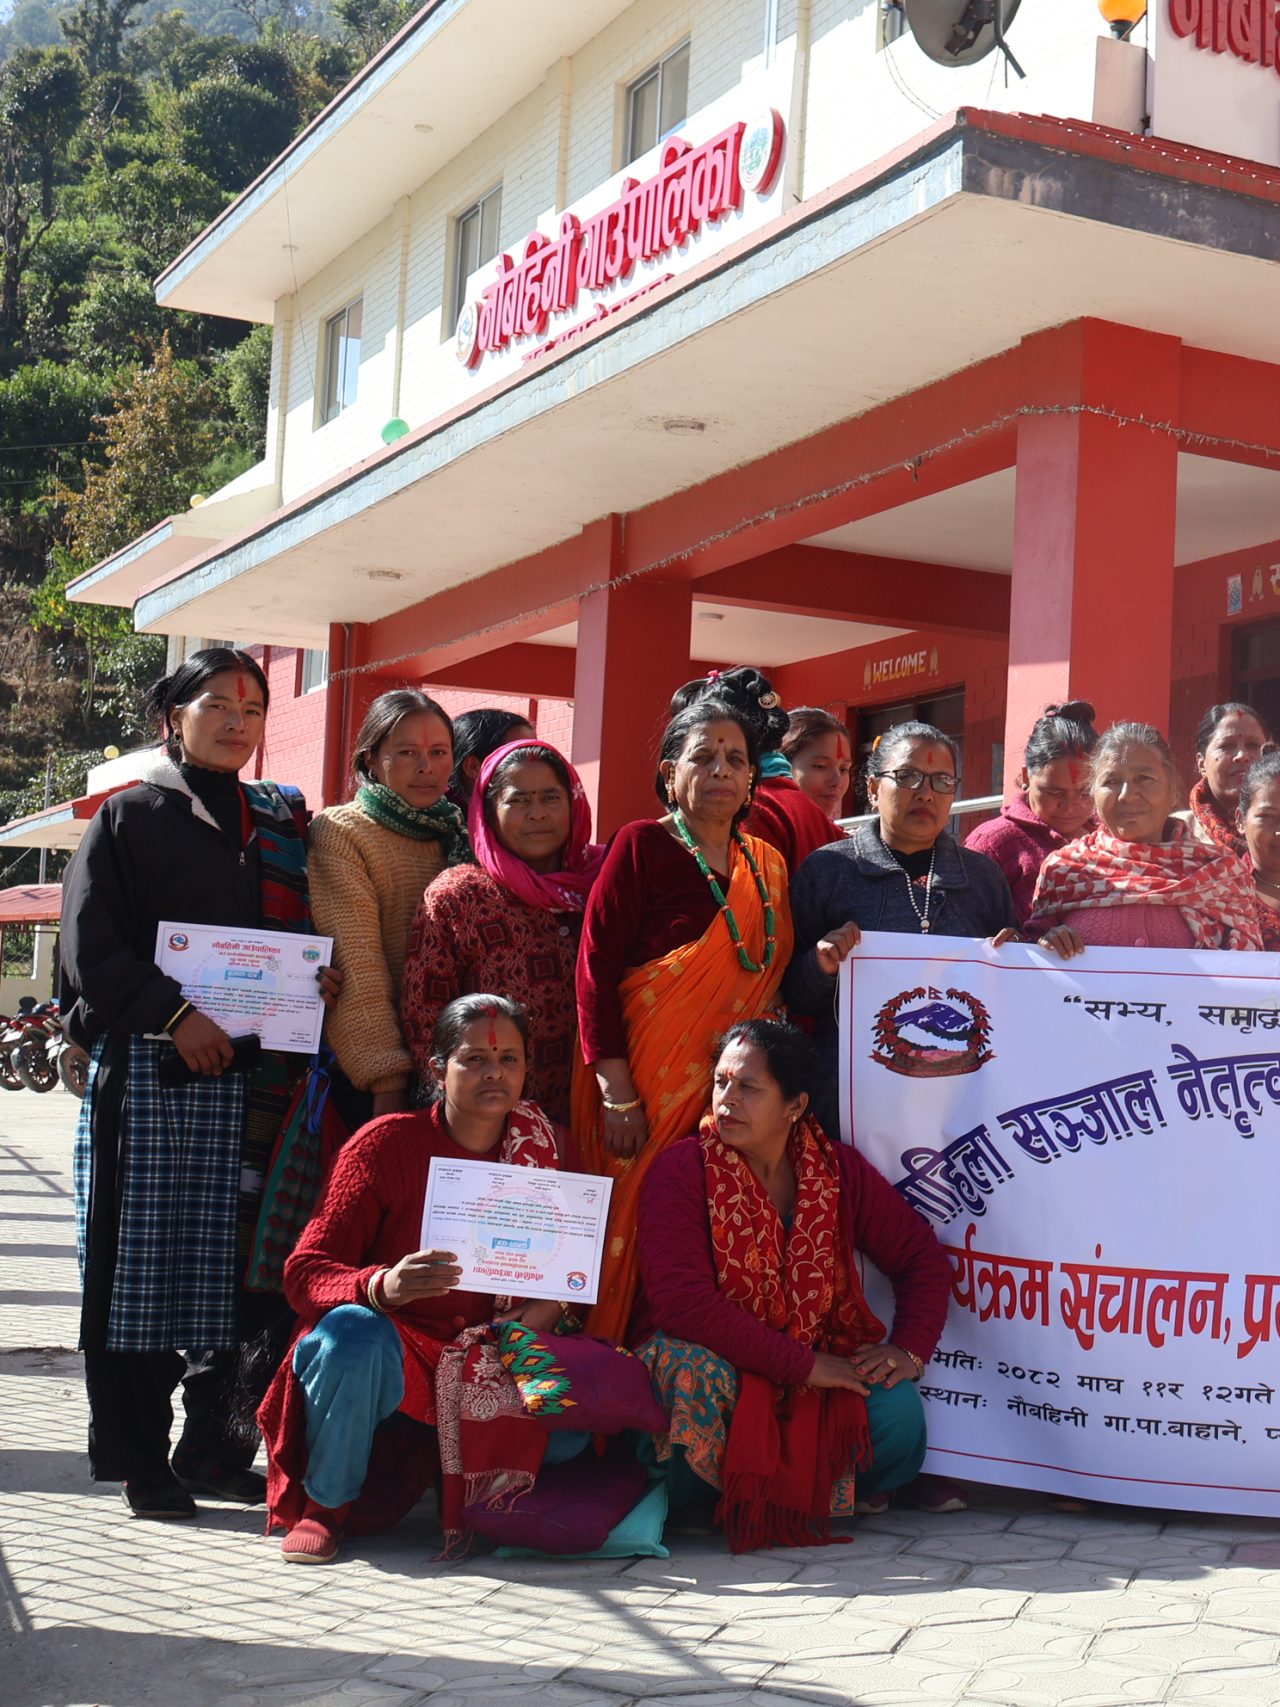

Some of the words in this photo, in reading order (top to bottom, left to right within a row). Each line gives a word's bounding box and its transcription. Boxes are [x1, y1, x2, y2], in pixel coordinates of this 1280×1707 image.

[871, 650, 928, 684] WELCOME
[997, 1069, 1168, 1163] सञ्जाल
[997, 1361, 1060, 1387] २०८२
[1077, 1374, 1124, 1395] माघ
[1007, 1396, 1088, 1428] नौबहिनी
